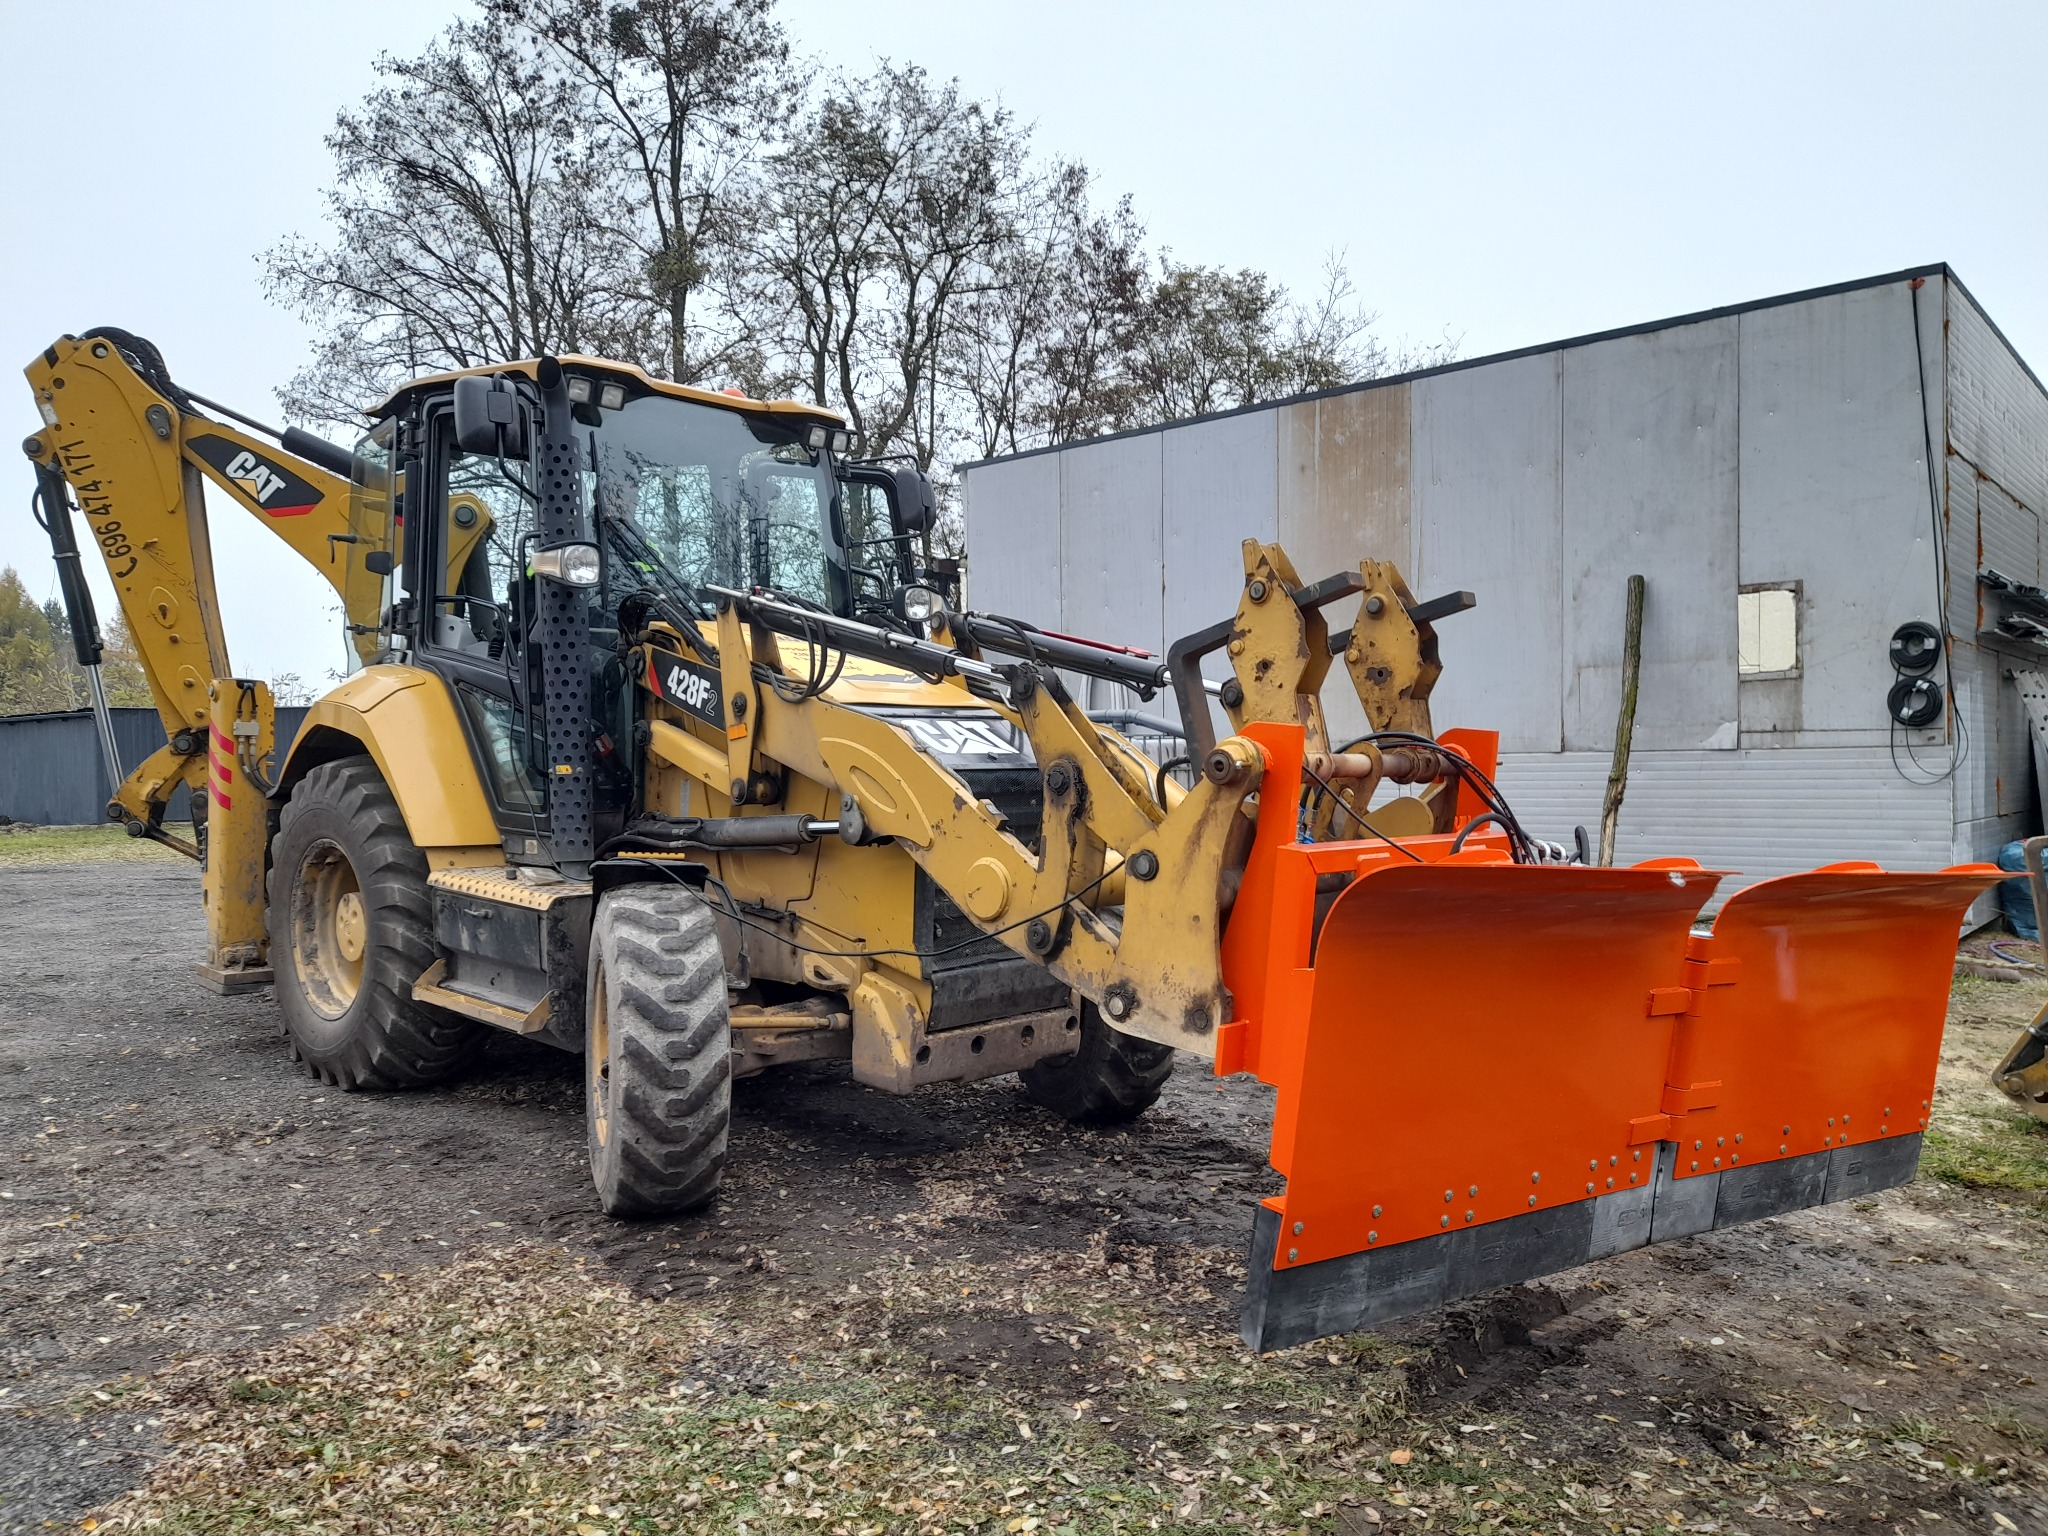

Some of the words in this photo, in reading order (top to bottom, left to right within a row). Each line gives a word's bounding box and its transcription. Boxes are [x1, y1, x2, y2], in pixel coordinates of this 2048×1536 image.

[58, 440, 96, 476] 171
[225, 451, 287, 504] CAT
[77, 479, 113, 516] 474
[95, 520, 132, 559] 696
[900, 719, 1020, 754] CAT
